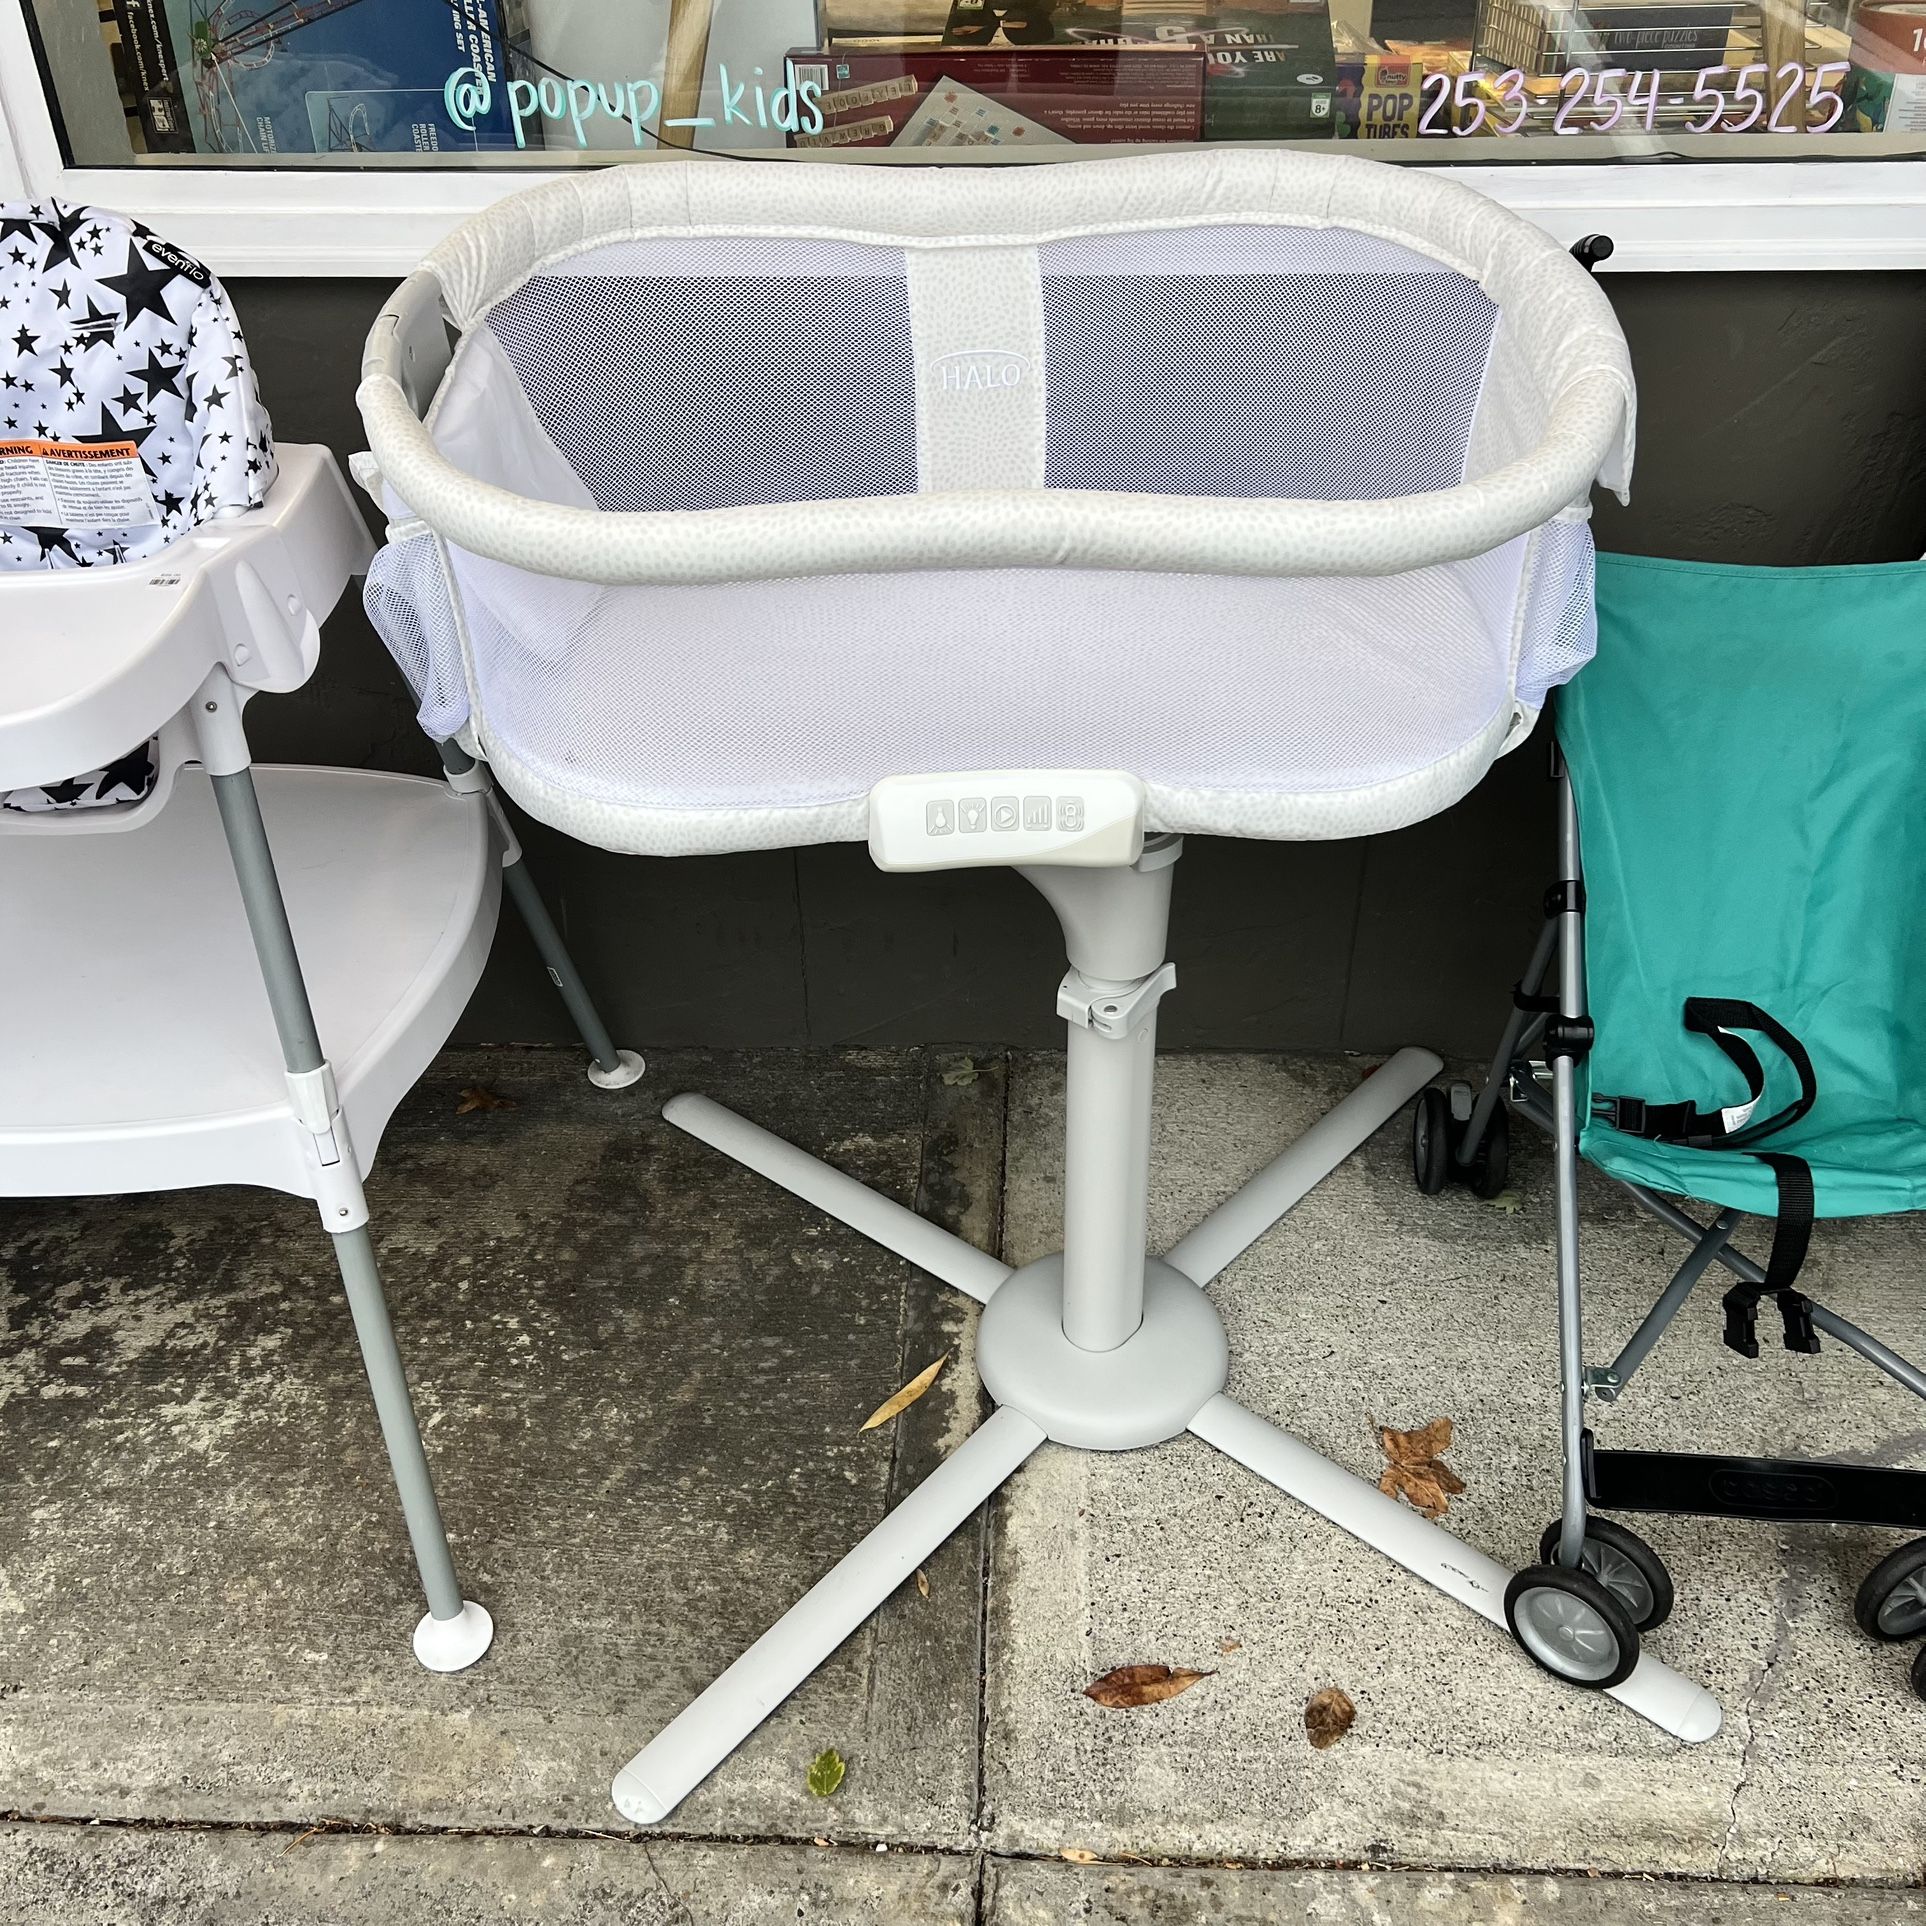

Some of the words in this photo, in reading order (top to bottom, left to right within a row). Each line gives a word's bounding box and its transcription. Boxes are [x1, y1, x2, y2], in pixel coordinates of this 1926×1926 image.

[127, 11, 150, 92] facebook.com/knex
[455, 32, 466, 53] SET
[1224, 33, 1275, 44] THAN
[1252, 50, 1286, 63] ARE
[1314, 104, 1326, 114] 8+
[1366, 93, 1414, 122] POP
[1417, 61, 1852, 136] 253-254-5525
[419, 123, 430, 151] ROLLER
[151, 243, 204, 280] evenflo
[942, 363, 1021, 390] HALO
[50, 447, 131, 459] AVERTISSEMENT
